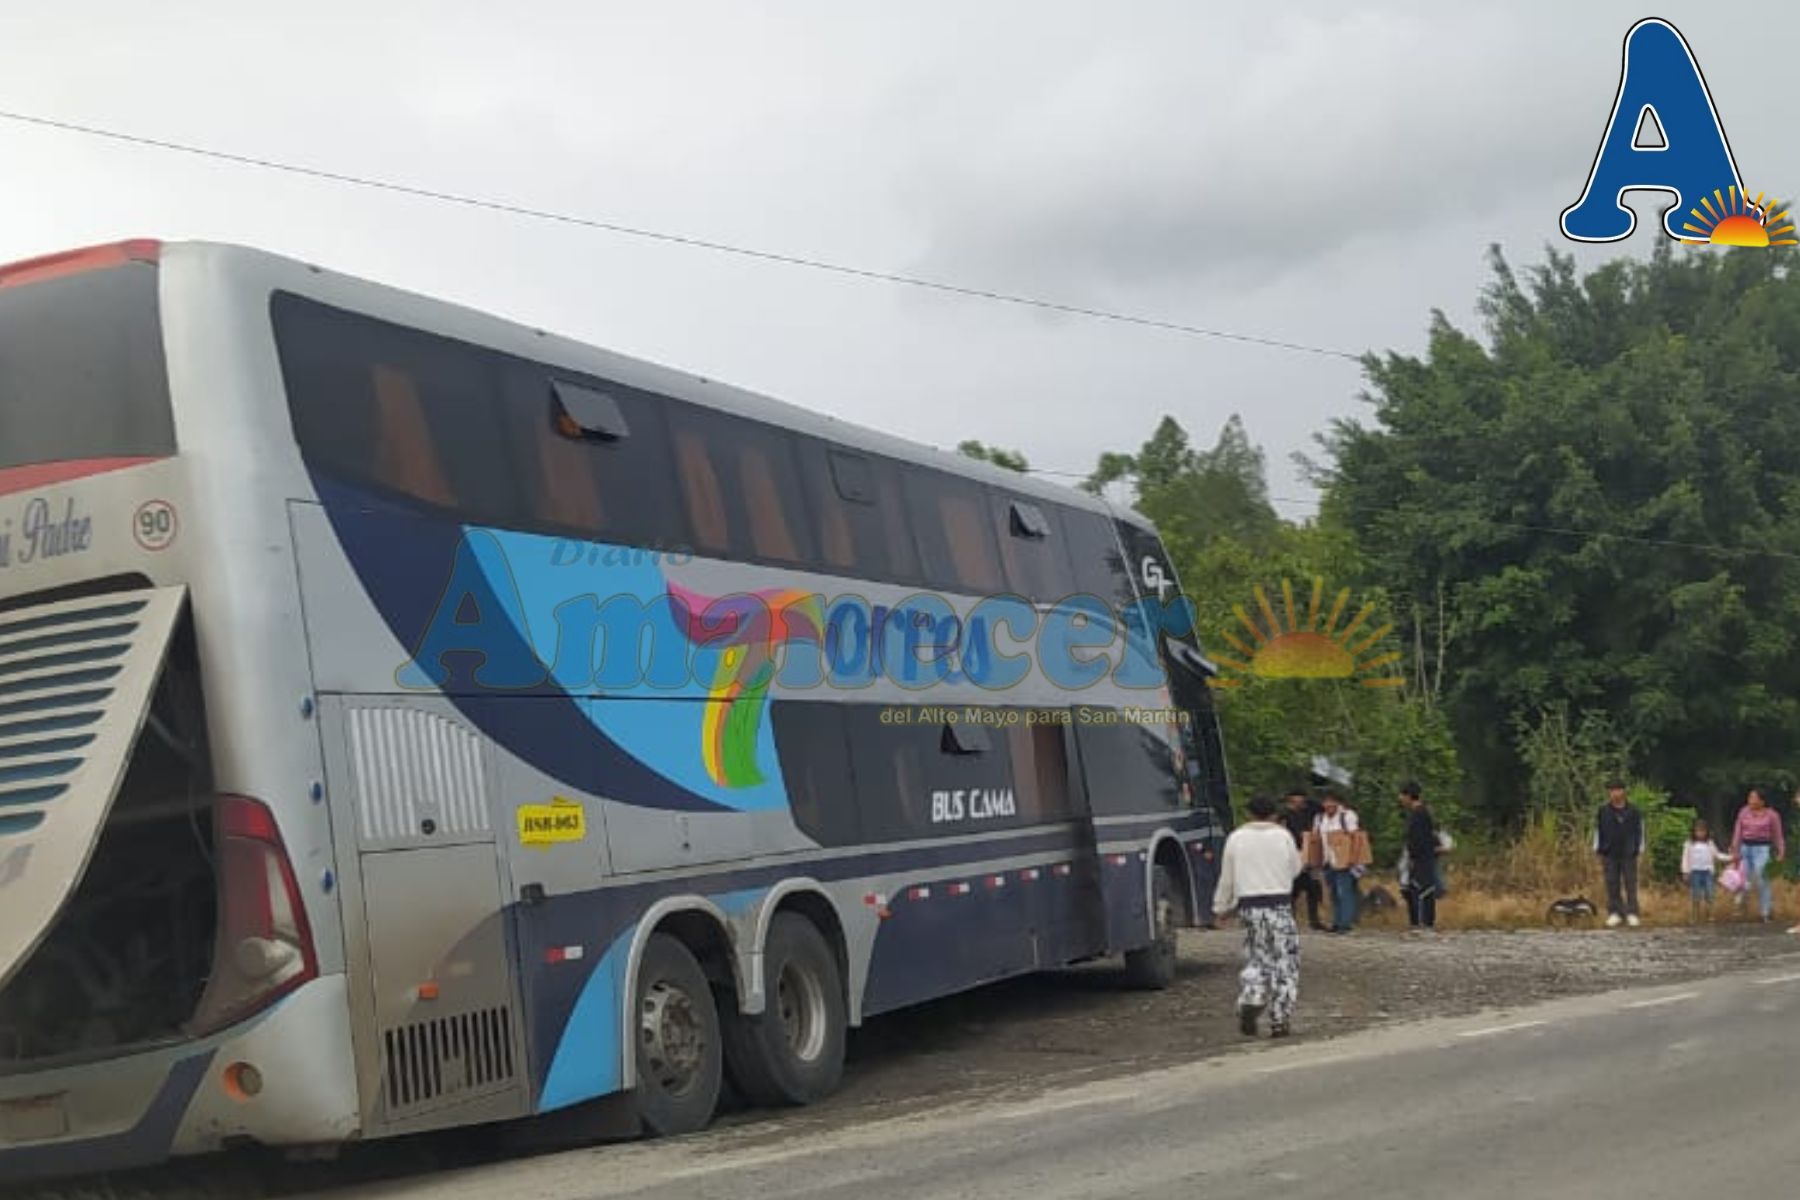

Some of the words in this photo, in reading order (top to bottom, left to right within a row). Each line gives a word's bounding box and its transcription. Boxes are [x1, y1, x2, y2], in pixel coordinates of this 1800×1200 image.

[18, 497, 91, 563] Padre
[139, 509, 171, 536] 90
[931, 790, 965, 824] BUS
[968, 789, 1016, 820] CAMA
